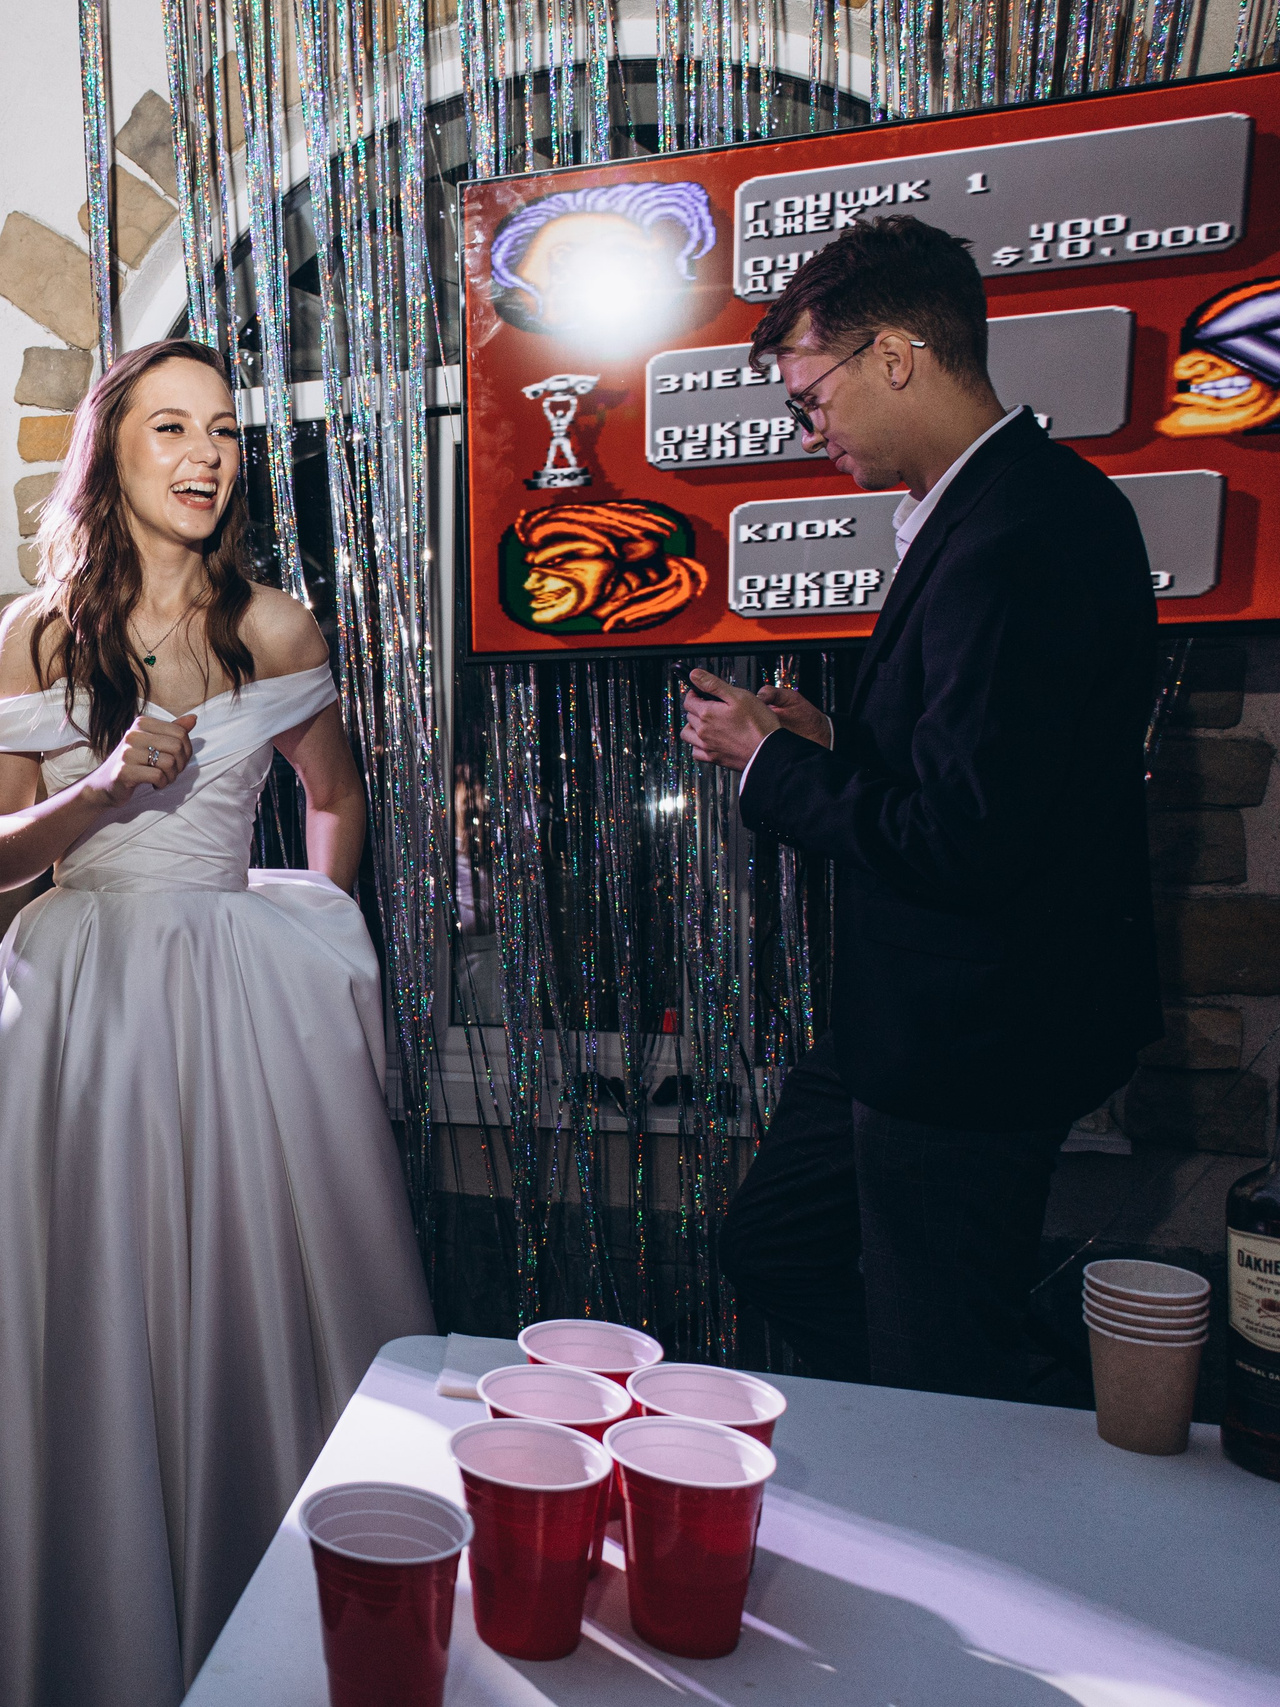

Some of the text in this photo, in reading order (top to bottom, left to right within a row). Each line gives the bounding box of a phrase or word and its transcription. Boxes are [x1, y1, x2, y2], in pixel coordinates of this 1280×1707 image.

[744, 172, 990, 222] ГОНЩИК 1
[744, 208, 861, 240] ДЖЕК
[1029, 213, 1128, 243] 400
[655, 416, 796, 445] ОЧКОВ
[655, 435, 791, 463] ДЕНЕГ
[739, 517, 853, 543] КЛОК
[738, 569, 881, 593] ОЧКОВ
[738, 587, 876, 611] ДЕНЕГ
